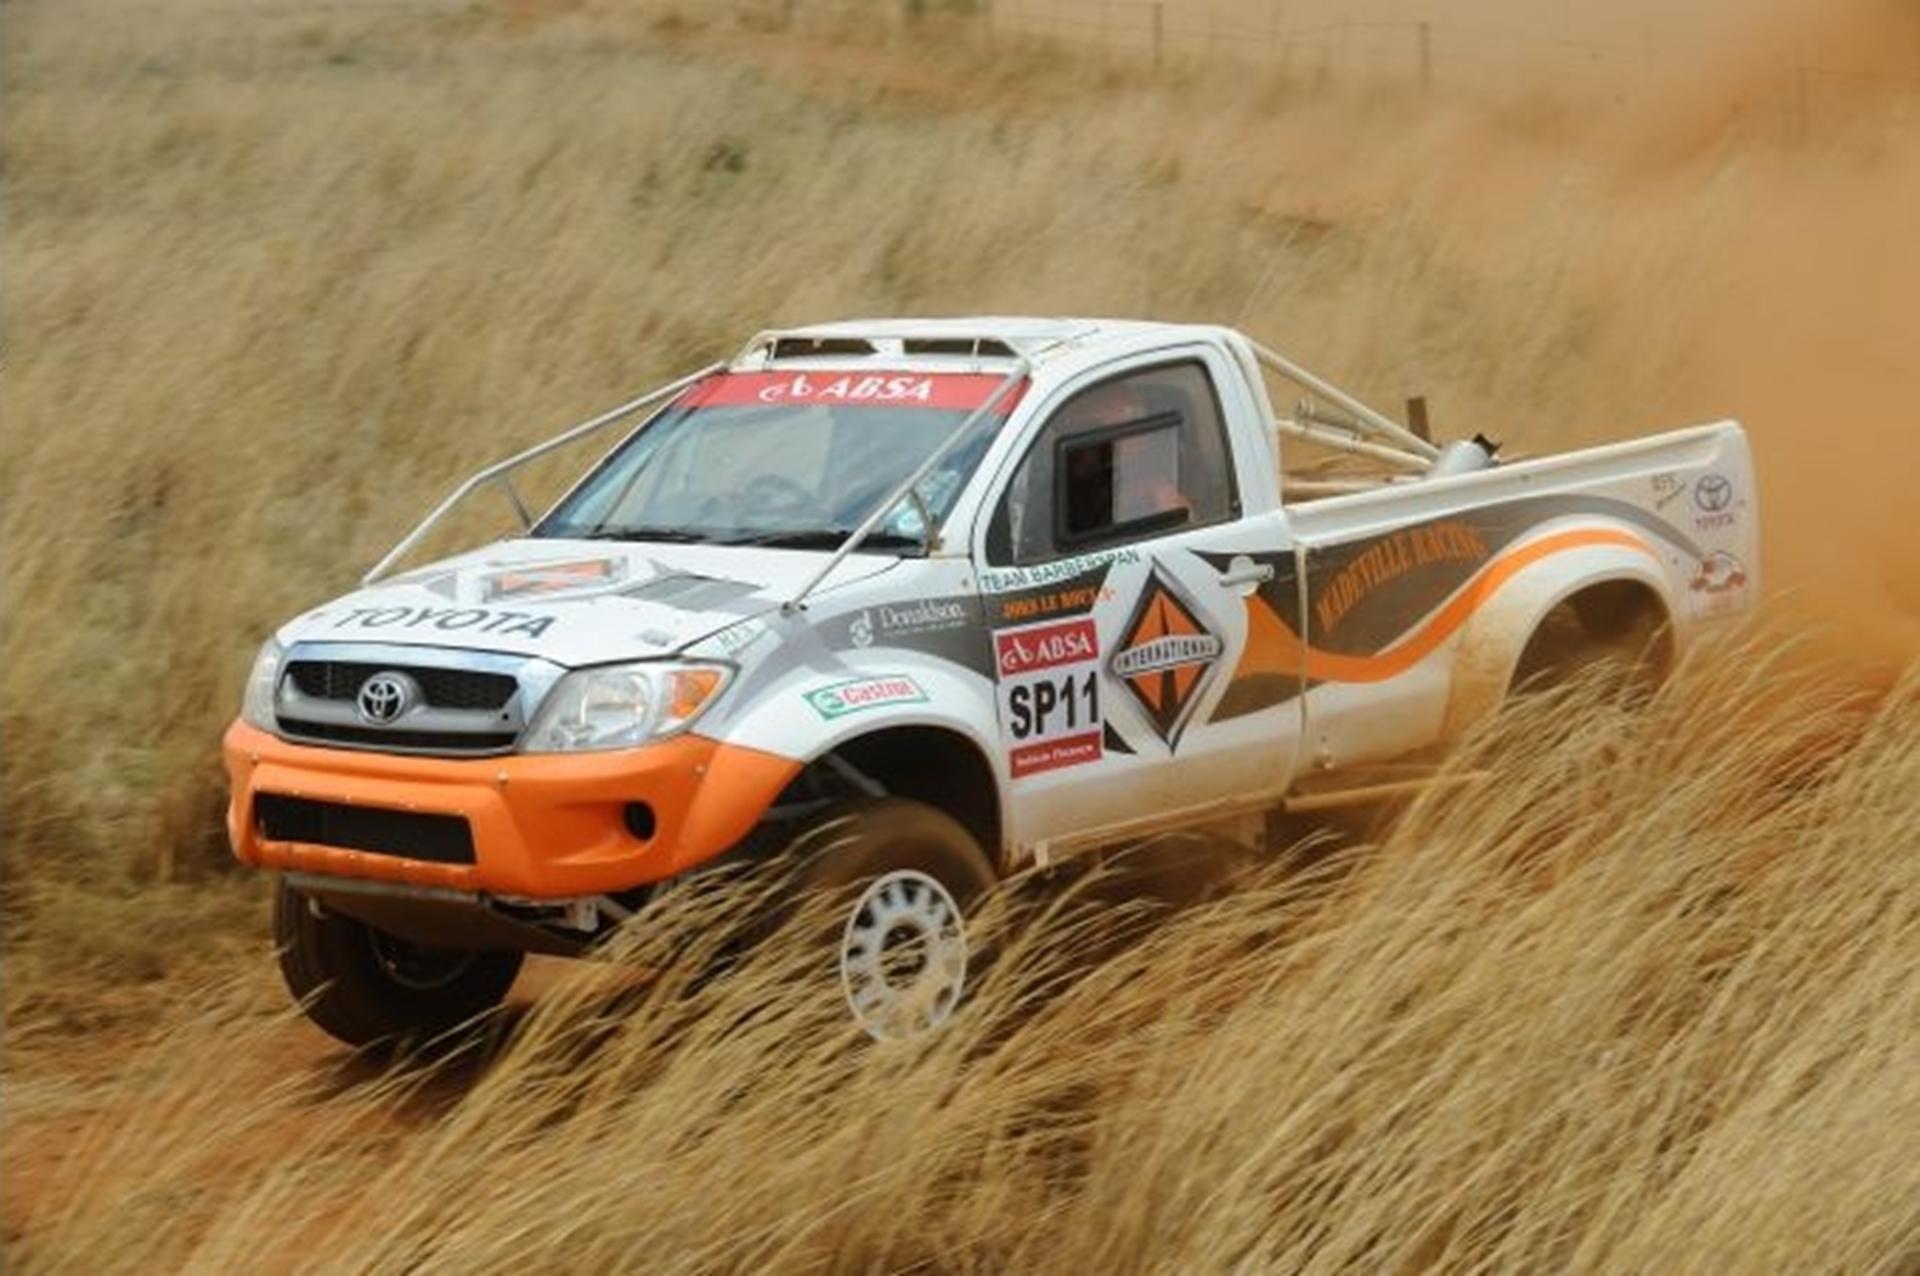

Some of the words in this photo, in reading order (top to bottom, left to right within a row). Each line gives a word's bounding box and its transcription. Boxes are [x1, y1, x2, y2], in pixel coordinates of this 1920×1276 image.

[819, 377, 933, 400] ABSA
[982, 570, 1028, 591] TEAM
[333, 606, 561, 639] TOYOTA
[880, 600, 967, 629] Donaldson
[1036, 633, 1093, 662] ABSA
[1117, 640, 1214, 667] INTERNATIONAL
[844, 681, 914, 705] Castrol
[1010, 671, 1097, 739] SP11
